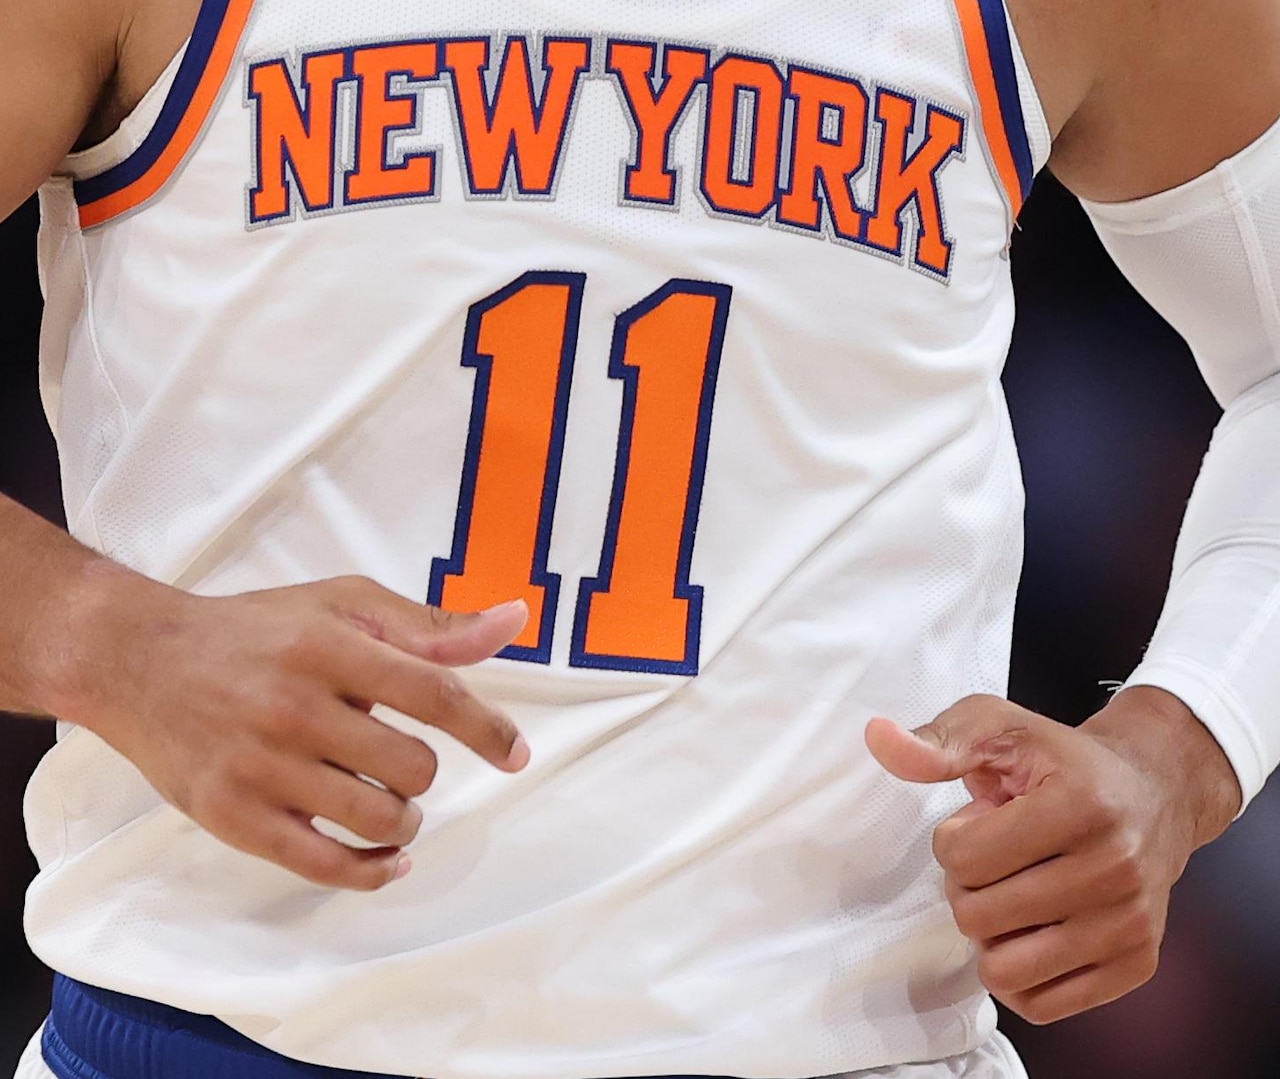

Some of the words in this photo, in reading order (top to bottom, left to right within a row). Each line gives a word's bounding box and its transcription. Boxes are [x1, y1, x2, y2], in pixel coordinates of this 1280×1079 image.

[246, 34, 593, 227] NEW
[604, 37, 968, 281] YORK
[426, 270, 733, 676] 11
